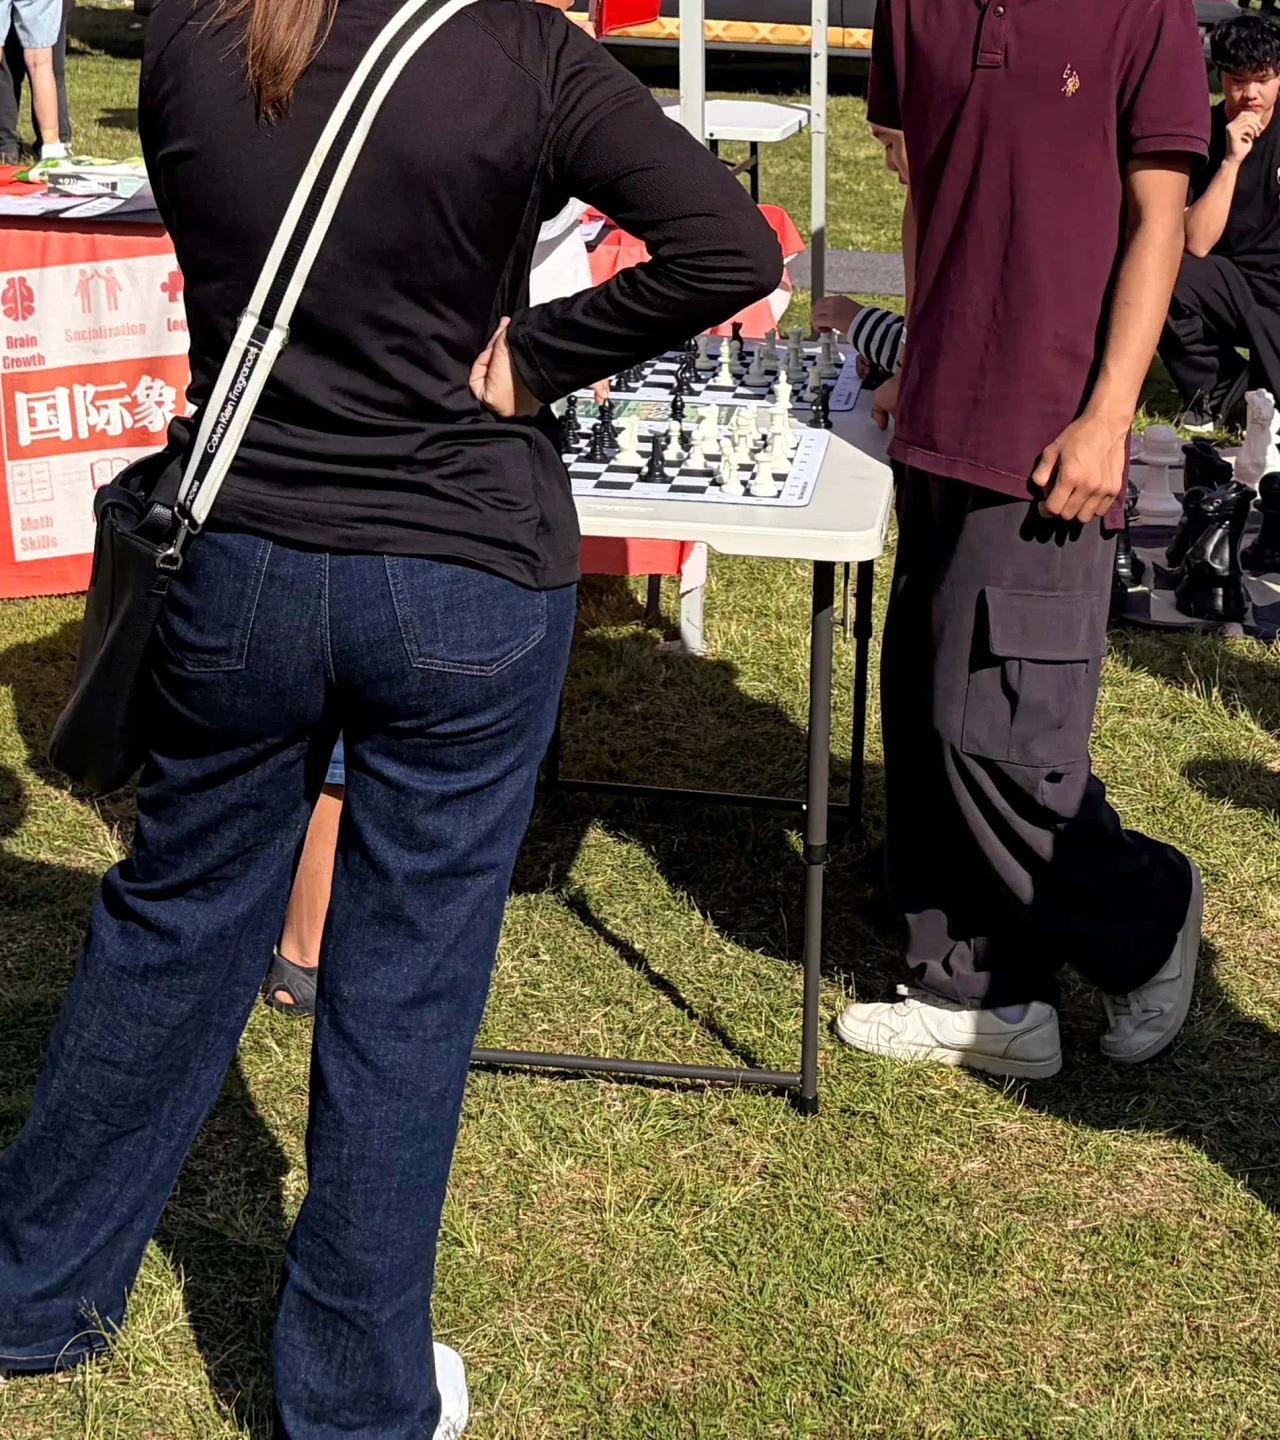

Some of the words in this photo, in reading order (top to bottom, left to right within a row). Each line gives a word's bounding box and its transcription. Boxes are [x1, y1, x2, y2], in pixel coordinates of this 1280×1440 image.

[63, 320, 147, 344] Socialization
[166, 317, 188, 333] Log
[4, 333, 39, 351] Brain
[1, 351, 47, 370] Growth
[14, 373, 194, 447] 国际象
[206, 420, 226, 455] Calvin
[218, 398, 236, 427] Klein
[229, 347, 258, 404] Fragrances
[19, 514, 55, 532] Math
[19, 532, 59, 552] Skills
